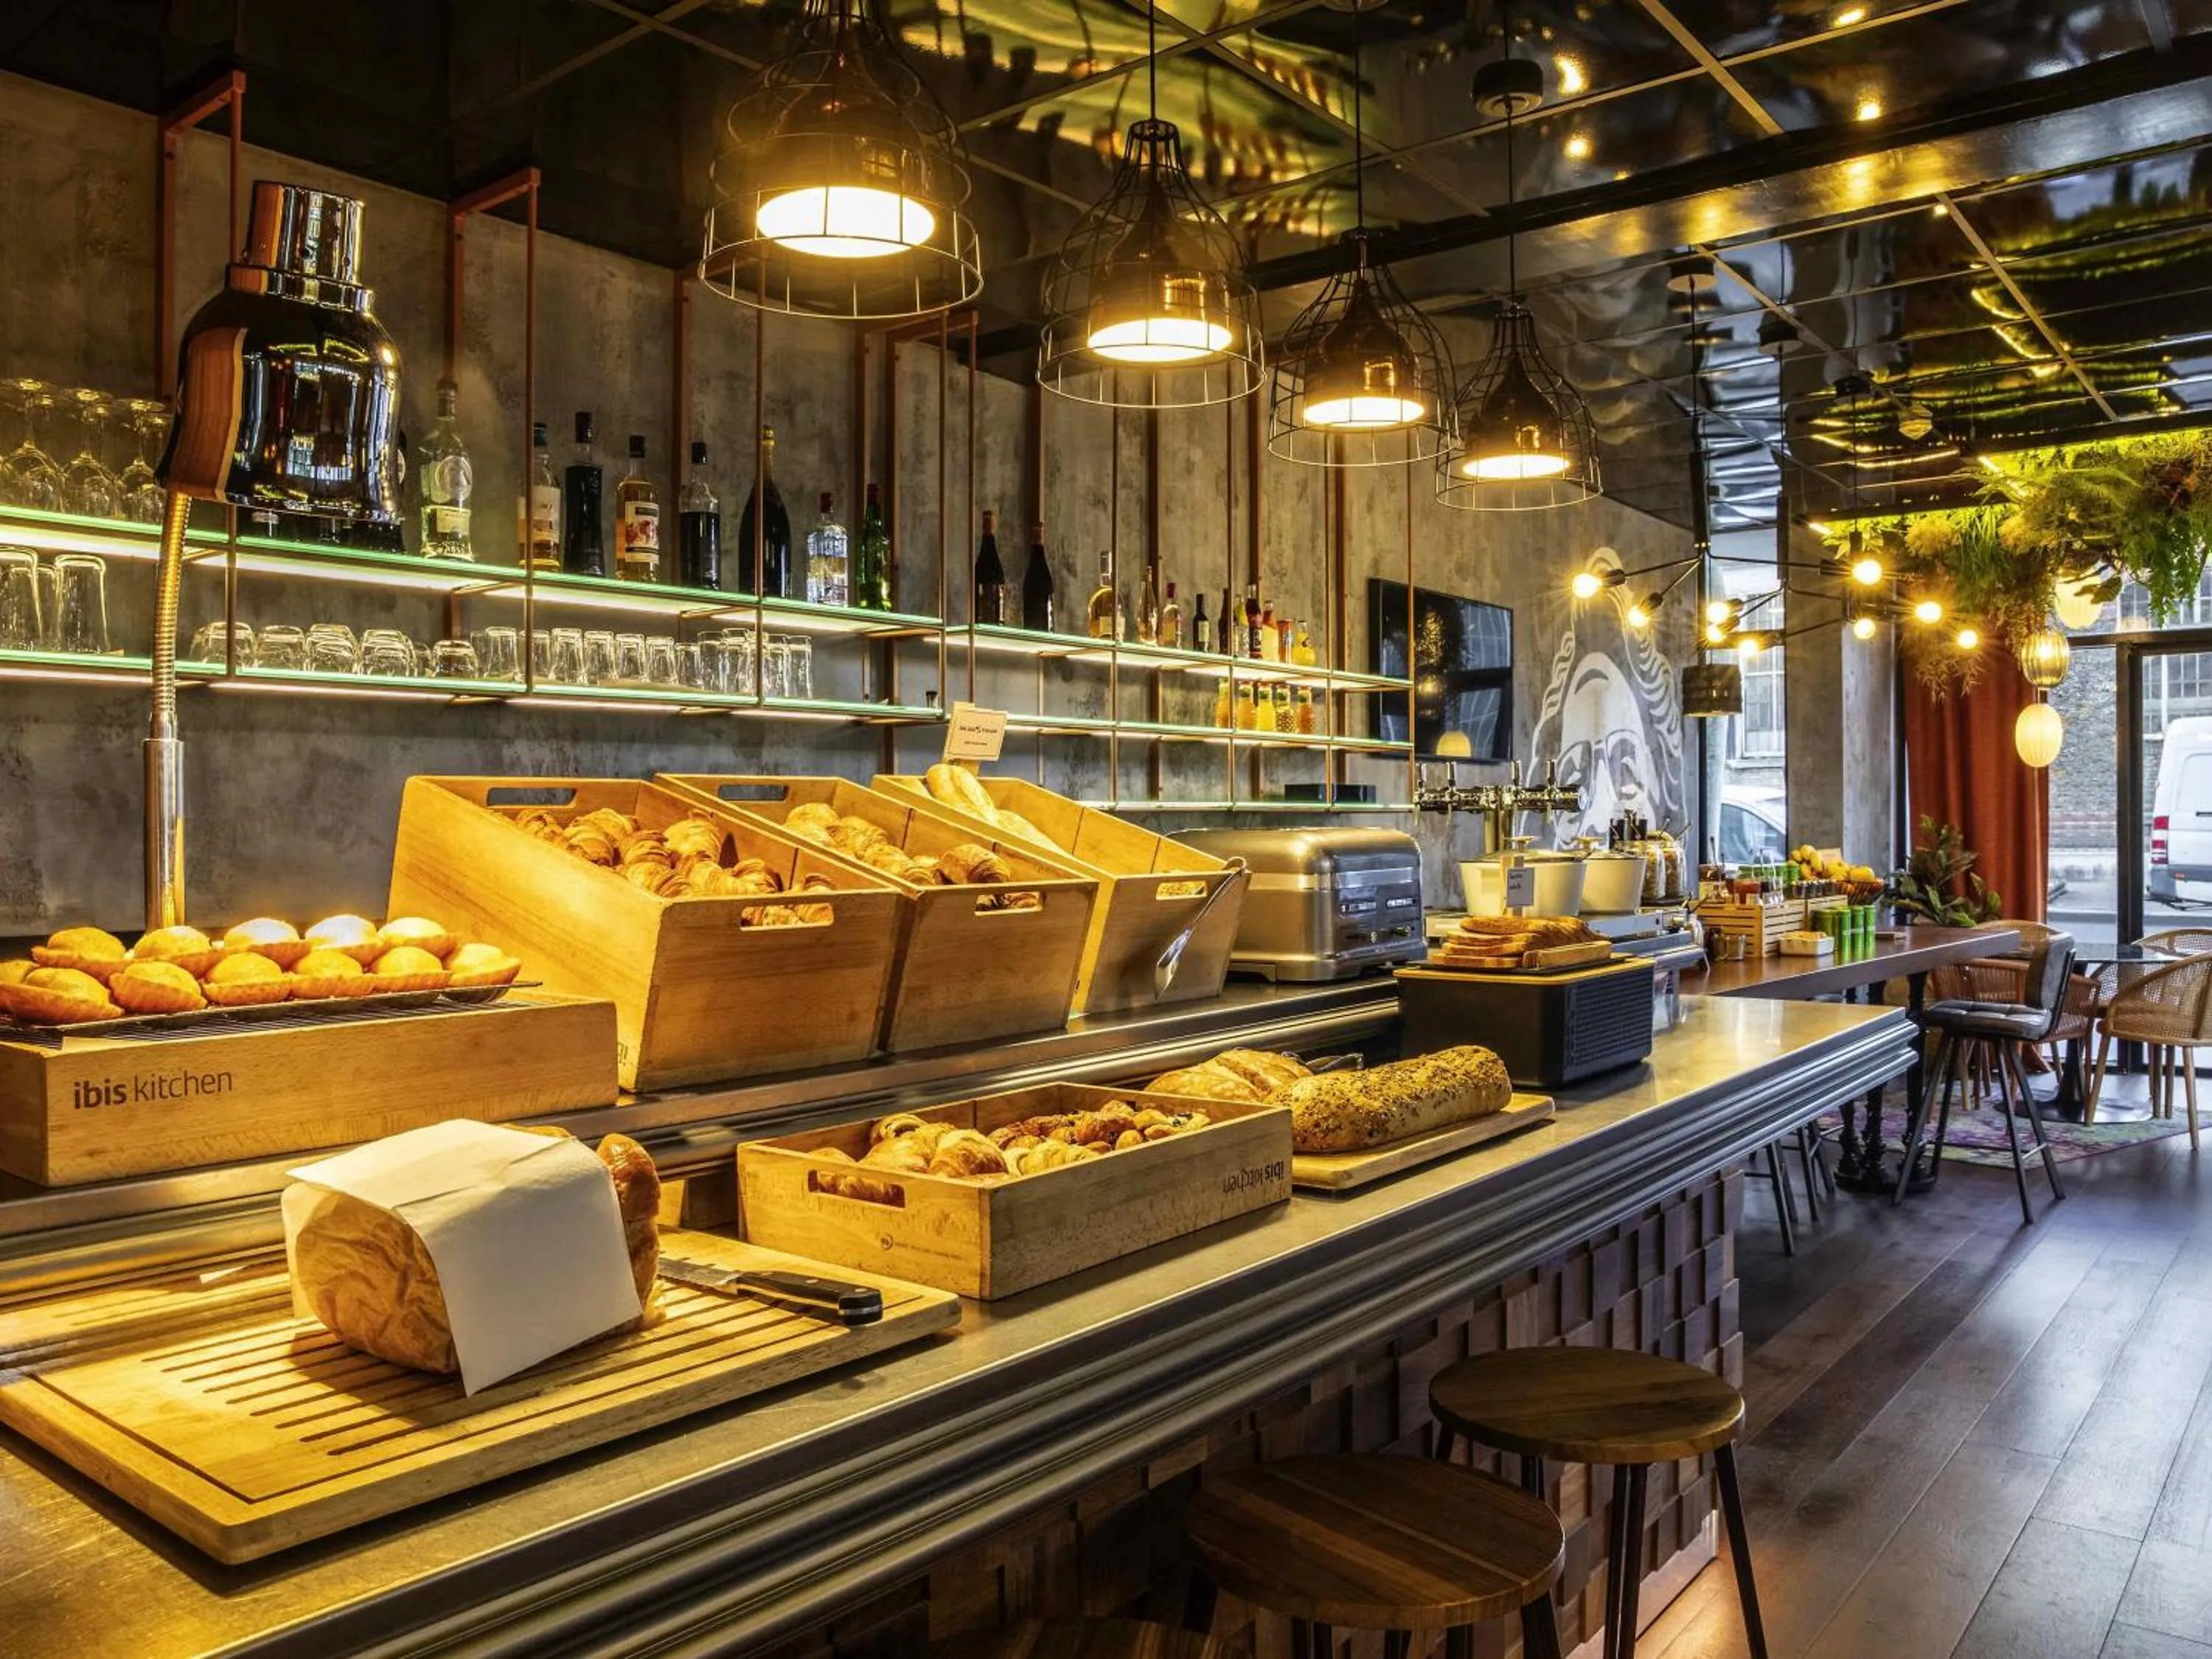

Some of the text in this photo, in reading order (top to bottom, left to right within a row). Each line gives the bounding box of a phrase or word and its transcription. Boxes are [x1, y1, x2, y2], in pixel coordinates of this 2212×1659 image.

[74, 1070, 233, 1110] ibis kitchen
[1222, 1161, 1284, 1193] ibis kitchen
